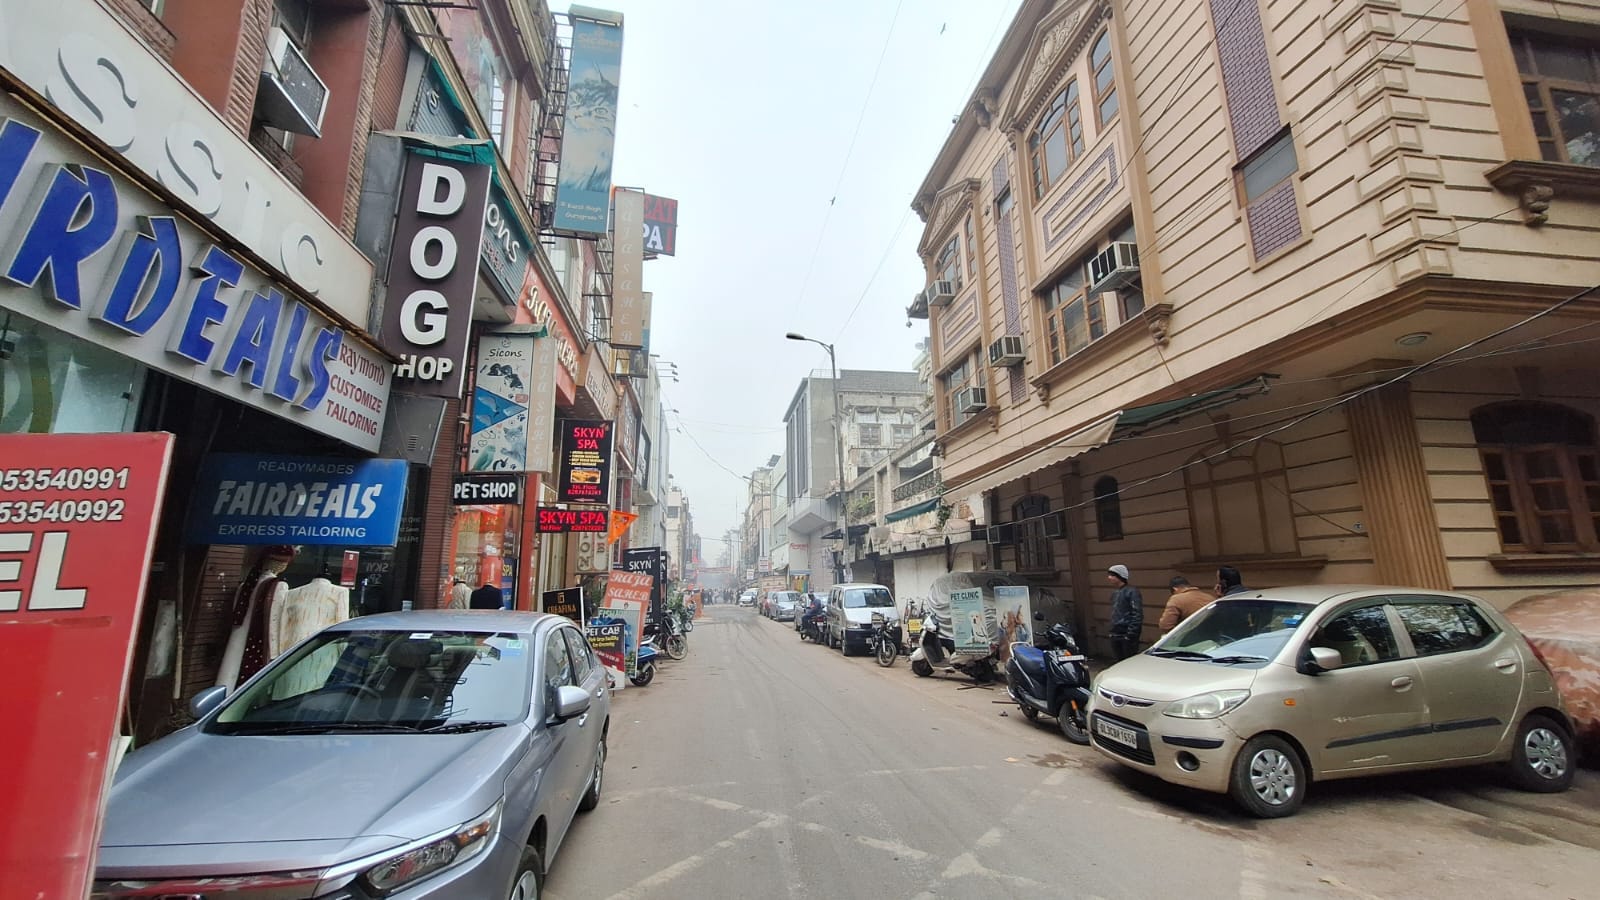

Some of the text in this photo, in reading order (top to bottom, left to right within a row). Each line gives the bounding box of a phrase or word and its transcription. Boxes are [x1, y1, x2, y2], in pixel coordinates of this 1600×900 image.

[400, 163, 467, 346] DOG
[488, 347, 523, 358] Sicons
[340, 342, 386, 387] Raymond
[392, 354, 454, 382] HOP
[329, 373, 383, 415] CUSTOMIZE
[326, 400, 378, 437] TAILORING
[573, 427, 605, 439] SKYN
[577, 439, 599, 450] SPA
[257, 460, 355, 476] READYMADES
[0, 467, 130, 492] 53540991
[453, 481, 517, 500] PET SHOP
[212, 479, 383, 520] FAIRDEALS
[539, 510, 606, 525] SKYN SPA
[217, 523, 367, 539] EXPRESS TAILORING
[628, 560, 652, 571] SKYN
[609, 572, 651, 587] RAJA
[607, 586, 649, 601] SAHEB
[951, 590, 980, 601] PET CLINIC
[585, 626, 621, 637] PET CAB
